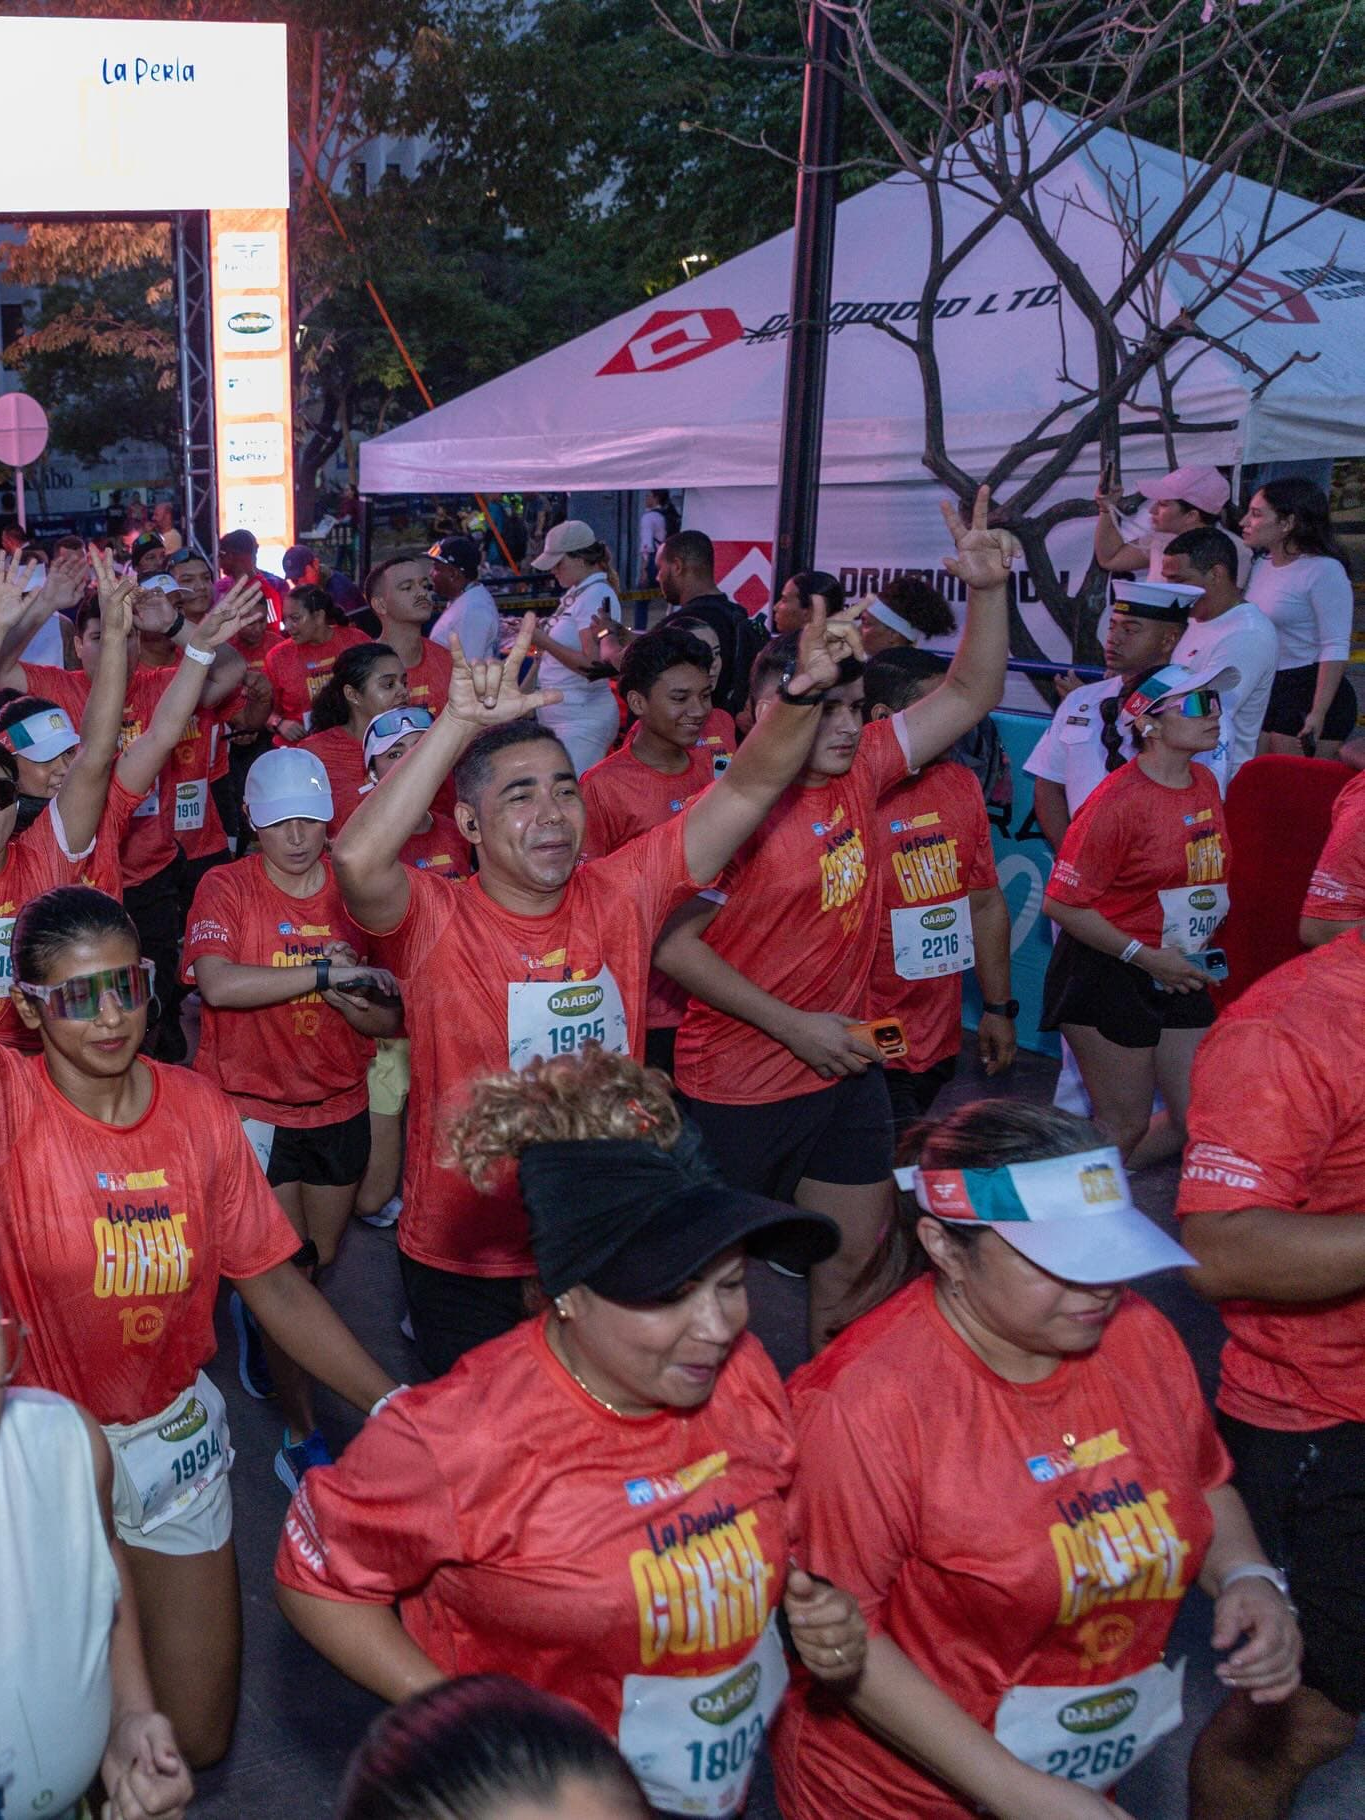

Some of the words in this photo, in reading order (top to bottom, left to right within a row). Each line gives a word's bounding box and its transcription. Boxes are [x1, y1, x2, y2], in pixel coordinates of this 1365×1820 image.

[102, 57, 127, 84] La
[135, 56, 195, 85] Perla
[176, 802, 200, 818] 1910
[892, 839, 963, 904] CORRE
[922, 911, 957, 926] DAABON
[922, 933, 959, 960] 2216
[551, 989, 603, 1010] DAABON
[547, 1017, 606, 1054] 1935
[125, 1200, 171, 1227] Perla
[94, 1213, 193, 1298] CORRE
[171, 1429, 222, 1486] 1934
[646, 1521, 677, 1556] La
[678, 1499, 738, 1548] Perla
[1050, 1489, 1192, 1627] CORRE
[629, 1509, 775, 1668] CORRE
[1047, 1733, 1137, 1780] 2266
